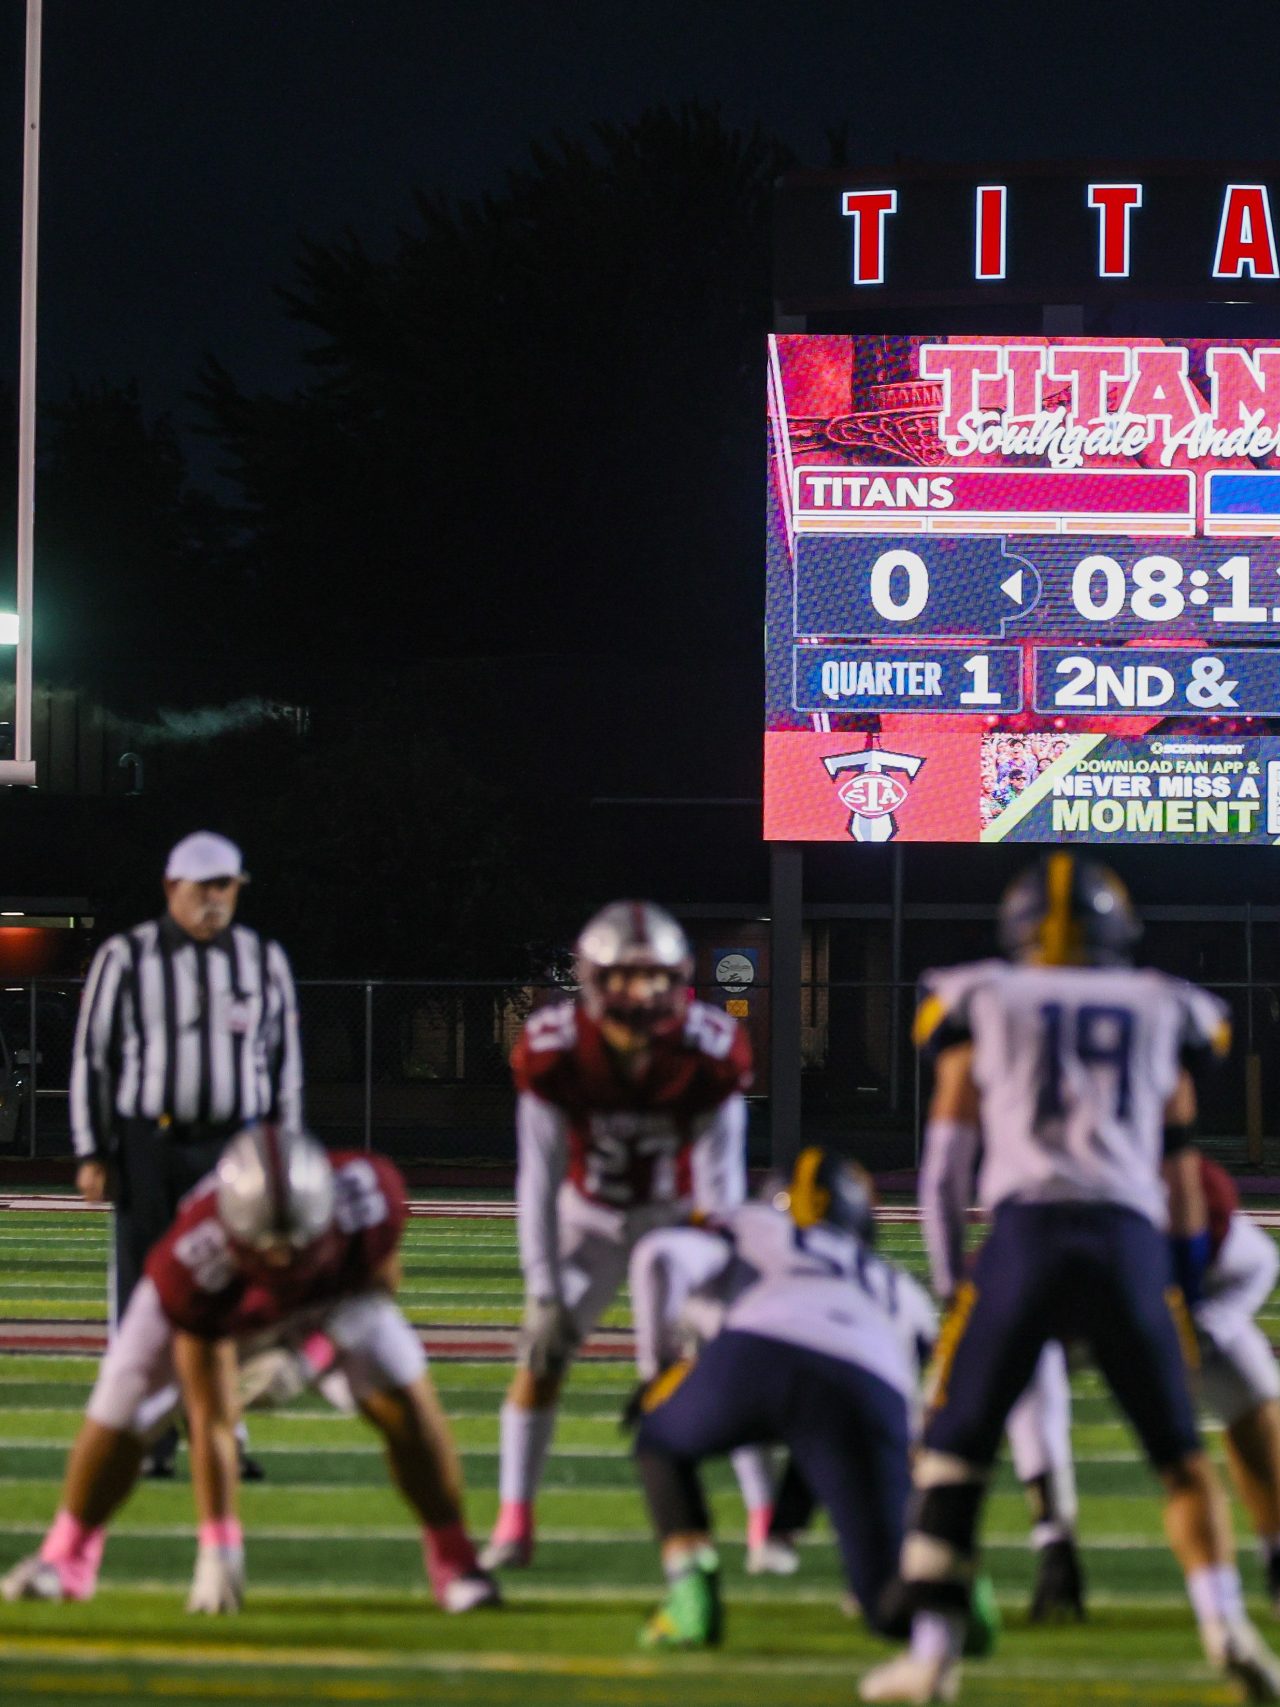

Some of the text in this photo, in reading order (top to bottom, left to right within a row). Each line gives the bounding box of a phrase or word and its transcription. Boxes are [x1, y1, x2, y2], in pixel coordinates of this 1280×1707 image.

[947, 405, 1149, 469] Southgate
[805, 476, 954, 508] TITANS
[870, 549, 929, 621] 0
[821, 655, 1001, 704] QUARTER 1
[1054, 656, 1175, 707] 2ND
[1186, 656, 1240, 709] &
[1052, 775, 1260, 798] NEVER MISS A
[1076, 760, 1260, 775] DOWNLOAD FAN APP &
[1052, 799, 1260, 833] MOMENT
[1031, 1001, 1135, 1134] 19
